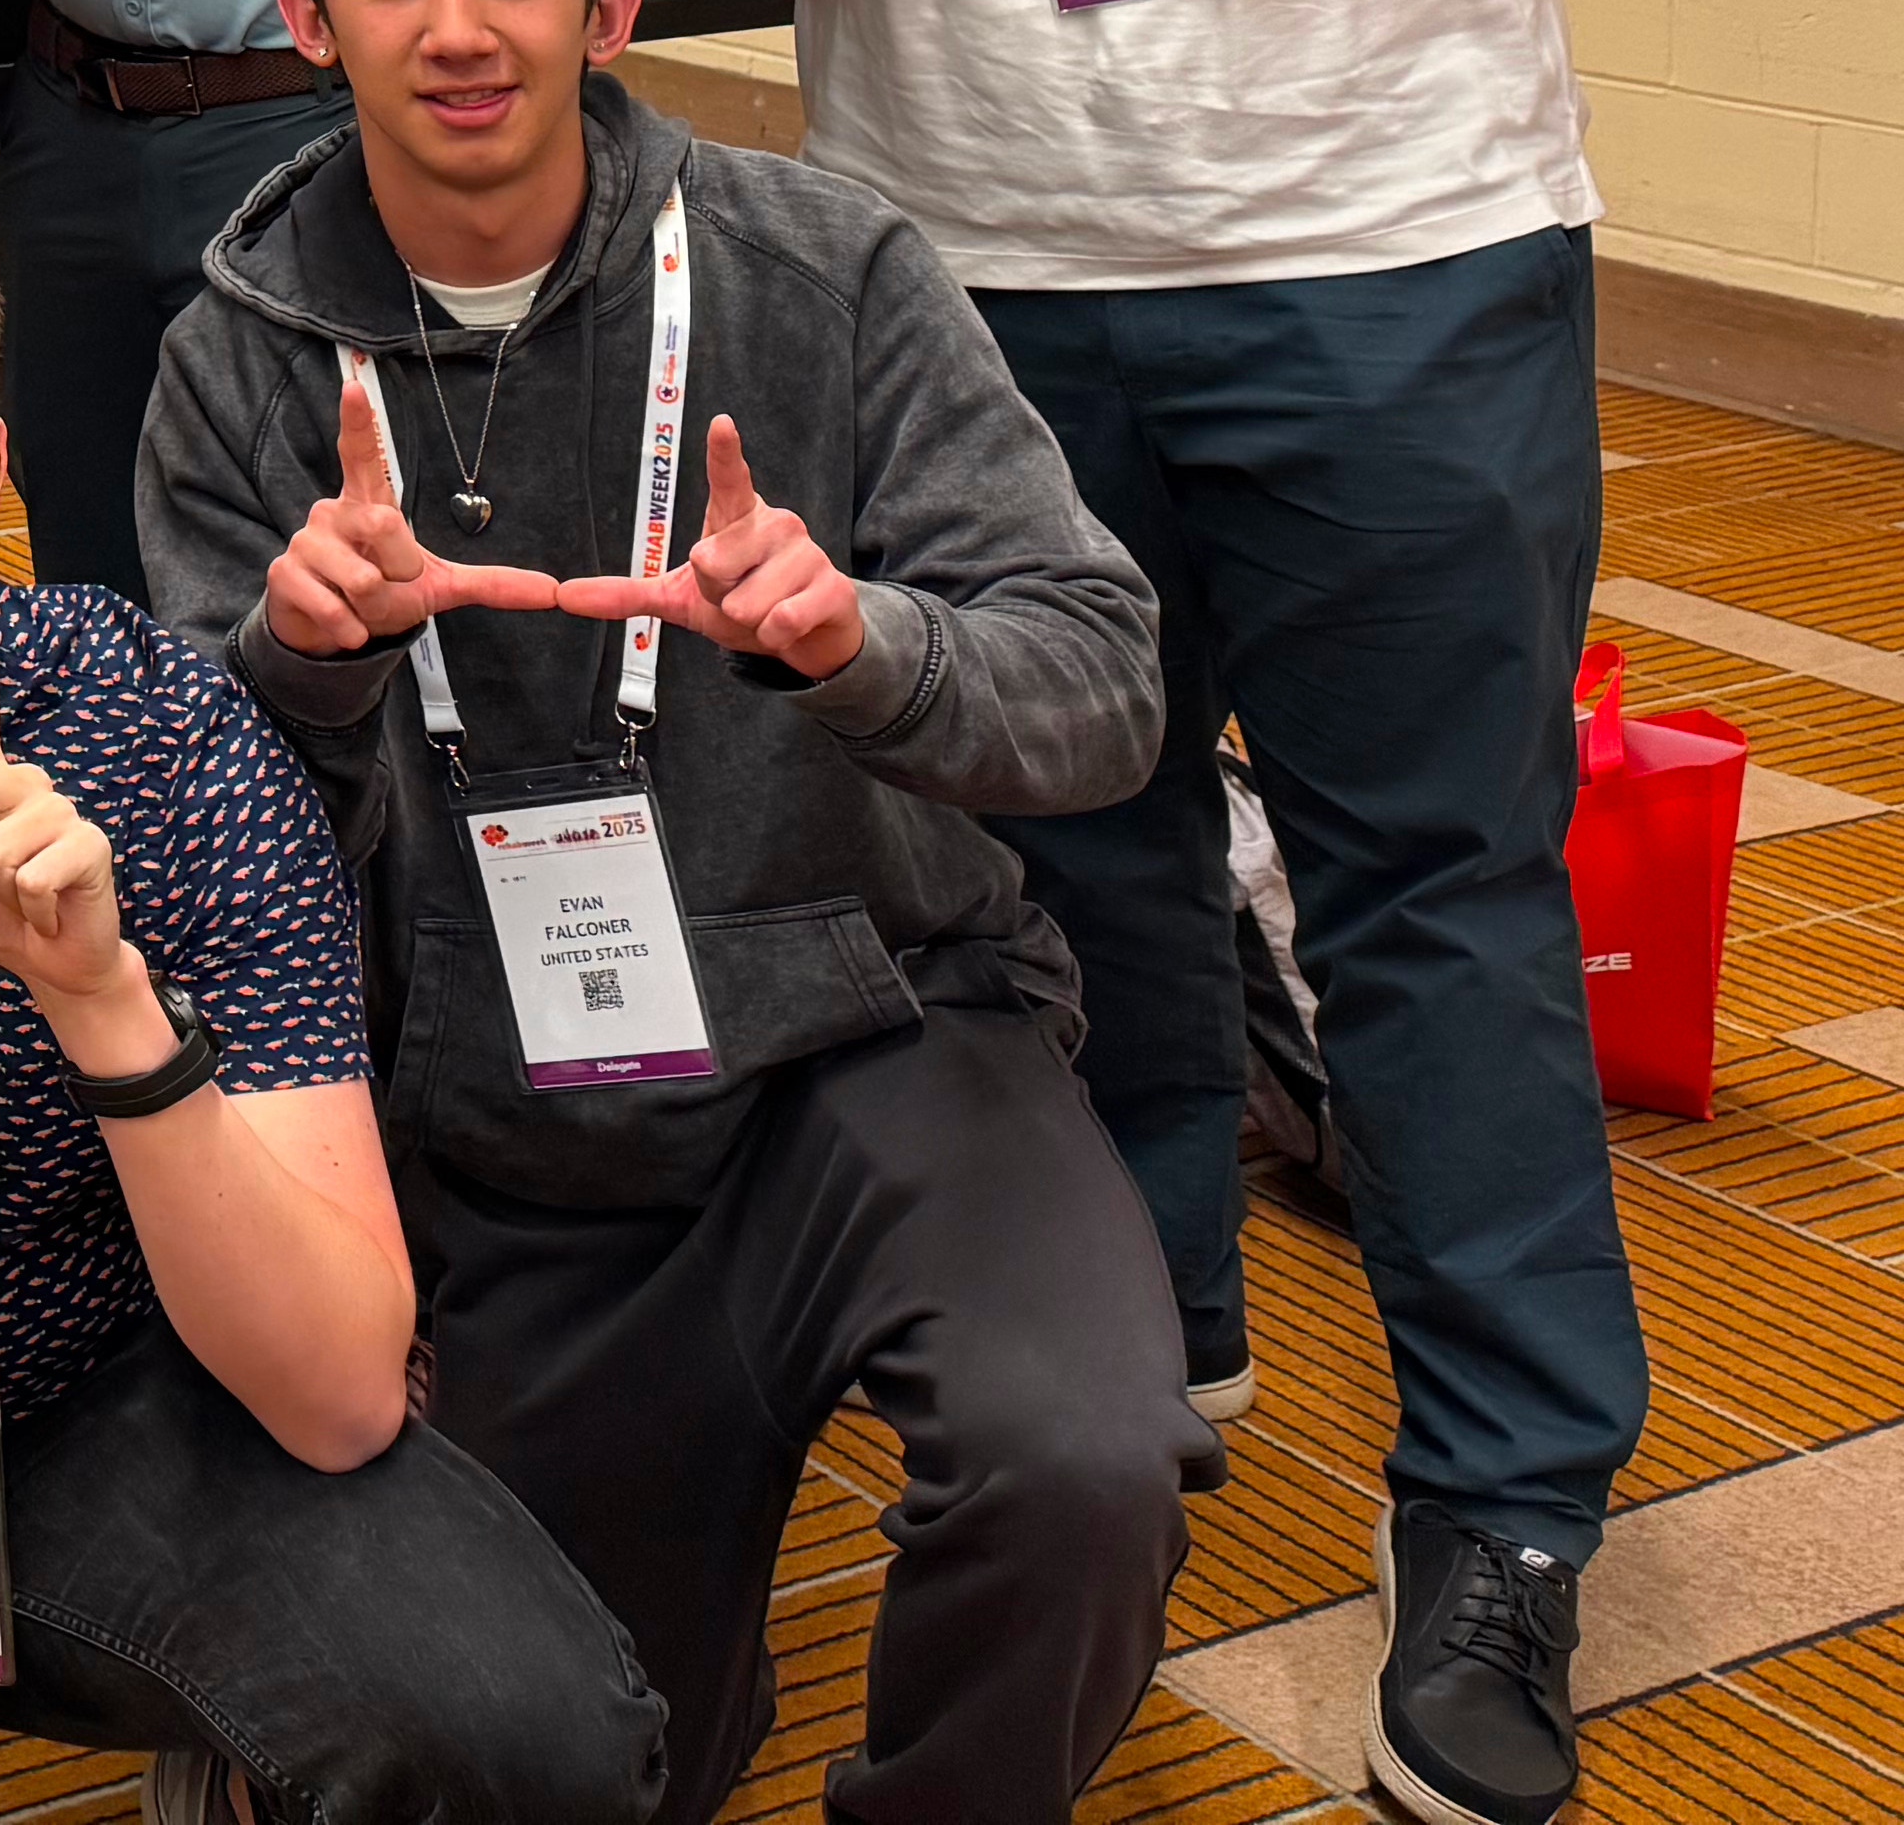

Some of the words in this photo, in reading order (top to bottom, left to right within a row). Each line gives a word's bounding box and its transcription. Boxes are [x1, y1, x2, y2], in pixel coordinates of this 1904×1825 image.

[643, 422, 674, 578] EHABWEEK2025
[601, 818, 646, 838] 2025
[559, 895, 604, 913] EVAN
[545, 918, 632, 941] FALCONER
[540, 949, 591, 966] UNITED
[595, 943, 648, 960] STATES
[1581, 952, 1632, 973] ZE
